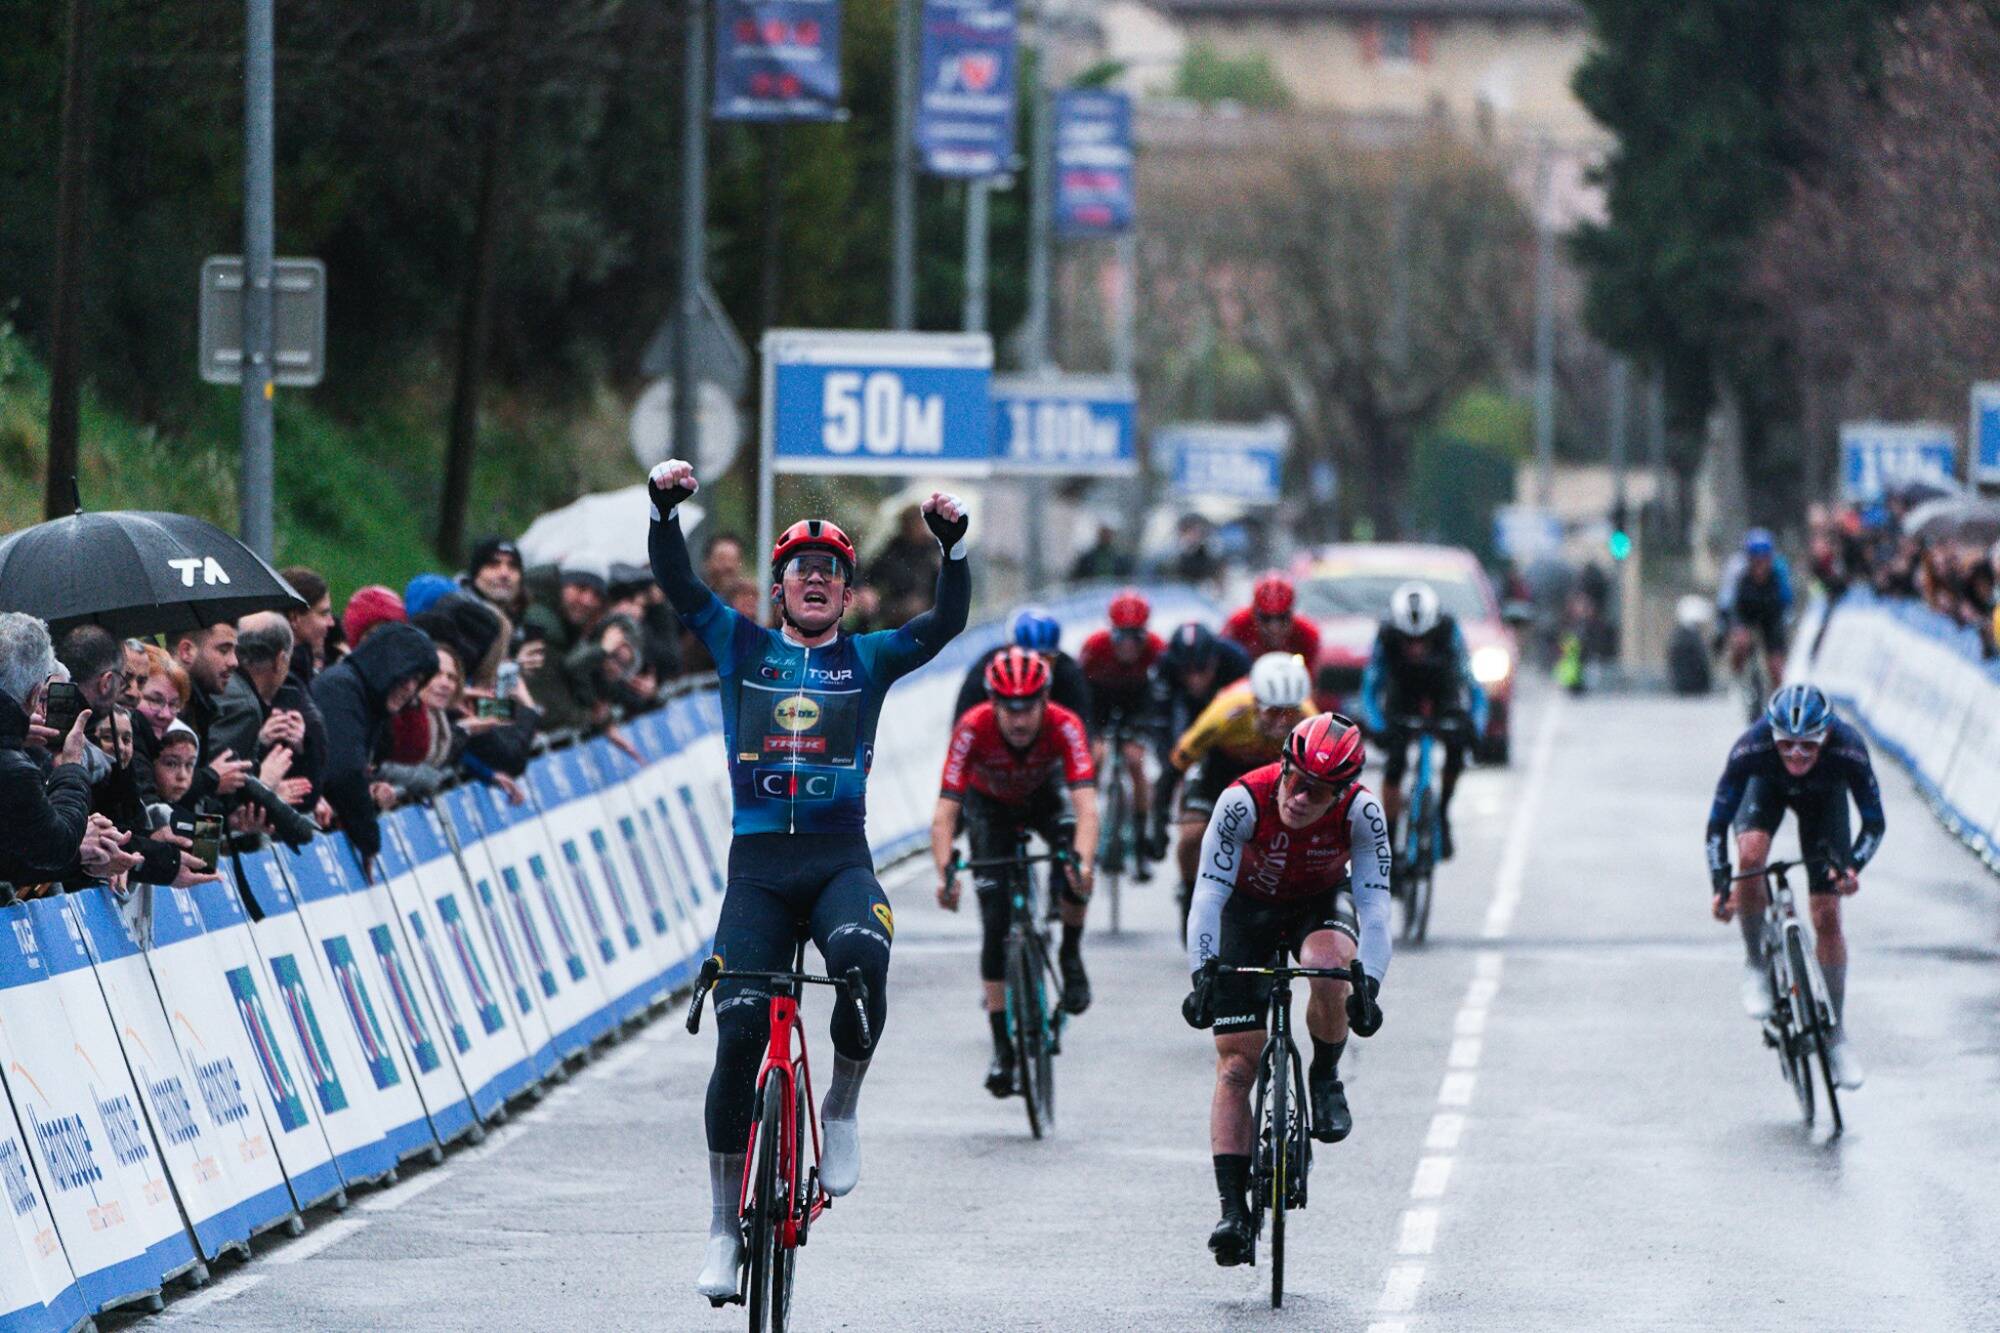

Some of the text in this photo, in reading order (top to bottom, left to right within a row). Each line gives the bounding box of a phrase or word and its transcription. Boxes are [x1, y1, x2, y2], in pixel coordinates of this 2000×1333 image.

[761, 666, 793, 681] CIC
[809, 668, 853, 681] TOUR
[763, 774, 828, 796] CIC
[1213, 801, 1248, 872] Cofidis
[239, 993, 295, 1103] CIC
[281, 983, 335, 1085] CIC
